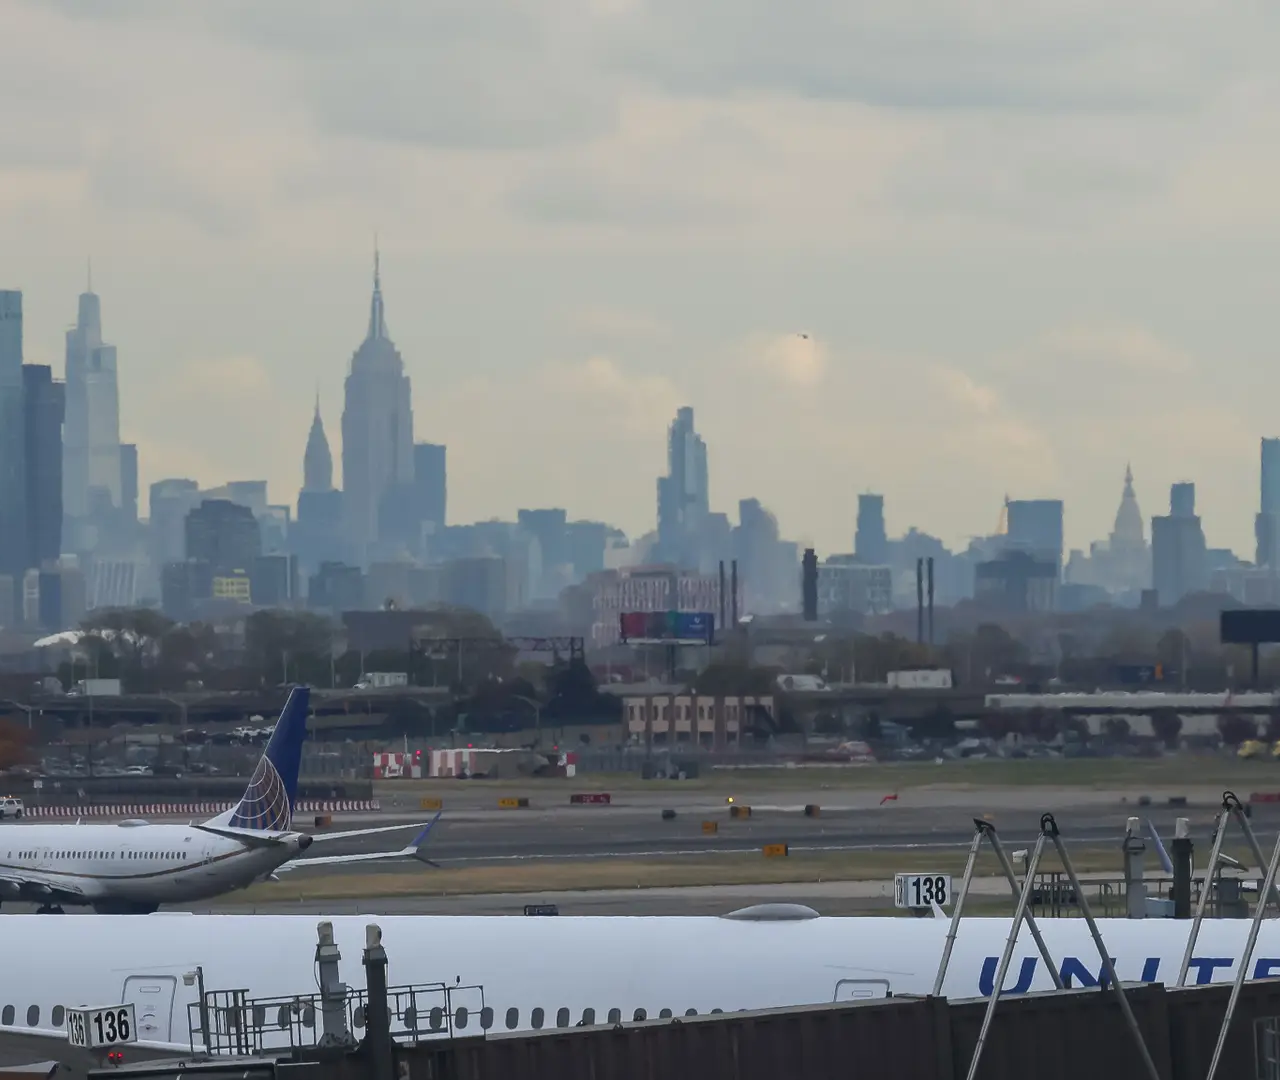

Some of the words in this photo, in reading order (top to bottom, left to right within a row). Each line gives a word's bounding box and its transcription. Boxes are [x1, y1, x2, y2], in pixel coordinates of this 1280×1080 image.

[912, 876, 947, 906] 138
[68, 1014, 86, 1047] 136
[93, 1009, 129, 1046] 136
